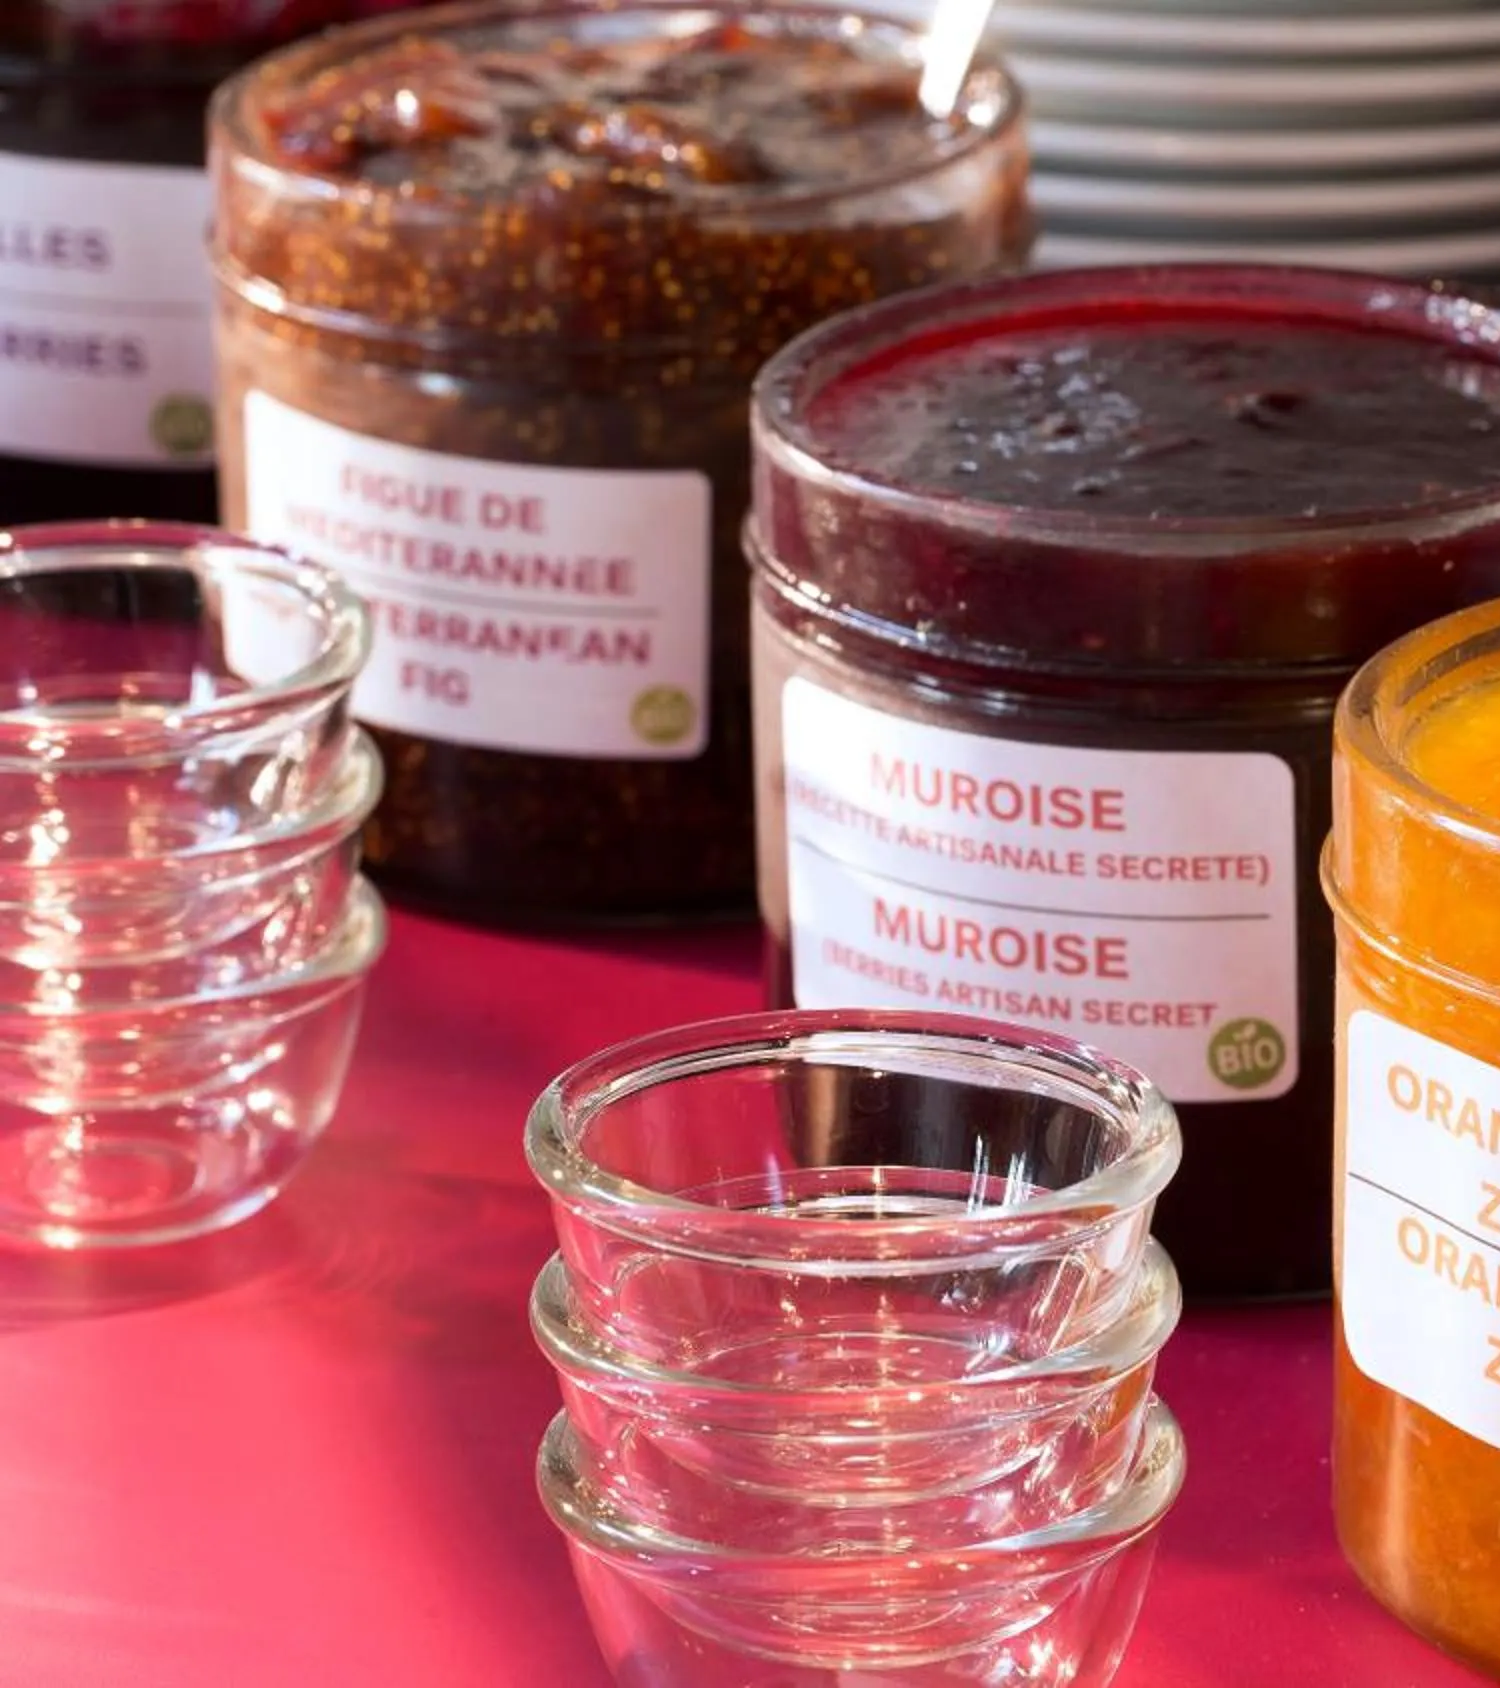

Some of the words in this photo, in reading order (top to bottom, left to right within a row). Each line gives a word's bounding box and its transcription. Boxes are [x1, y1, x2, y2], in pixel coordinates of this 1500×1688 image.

[339, 461, 464, 524] FIGUE
[479, 490, 547, 535] DE
[367, 596, 653, 668] TERRANEAN
[399, 659, 473, 708] FIG
[870, 752, 1127, 831] MUROISE
[896, 824, 1086, 877] ARTISANALE
[1096, 853, 1271, 886] SECRETE)
[873, 896, 1130, 980] MUROISE
[822, 937, 930, 996] (BERRIES
[936, 977, 1072, 1022] ARTISAN
[1083, 1000, 1219, 1029] SECRET
[1215, 1039, 1279, 1076] BIO
